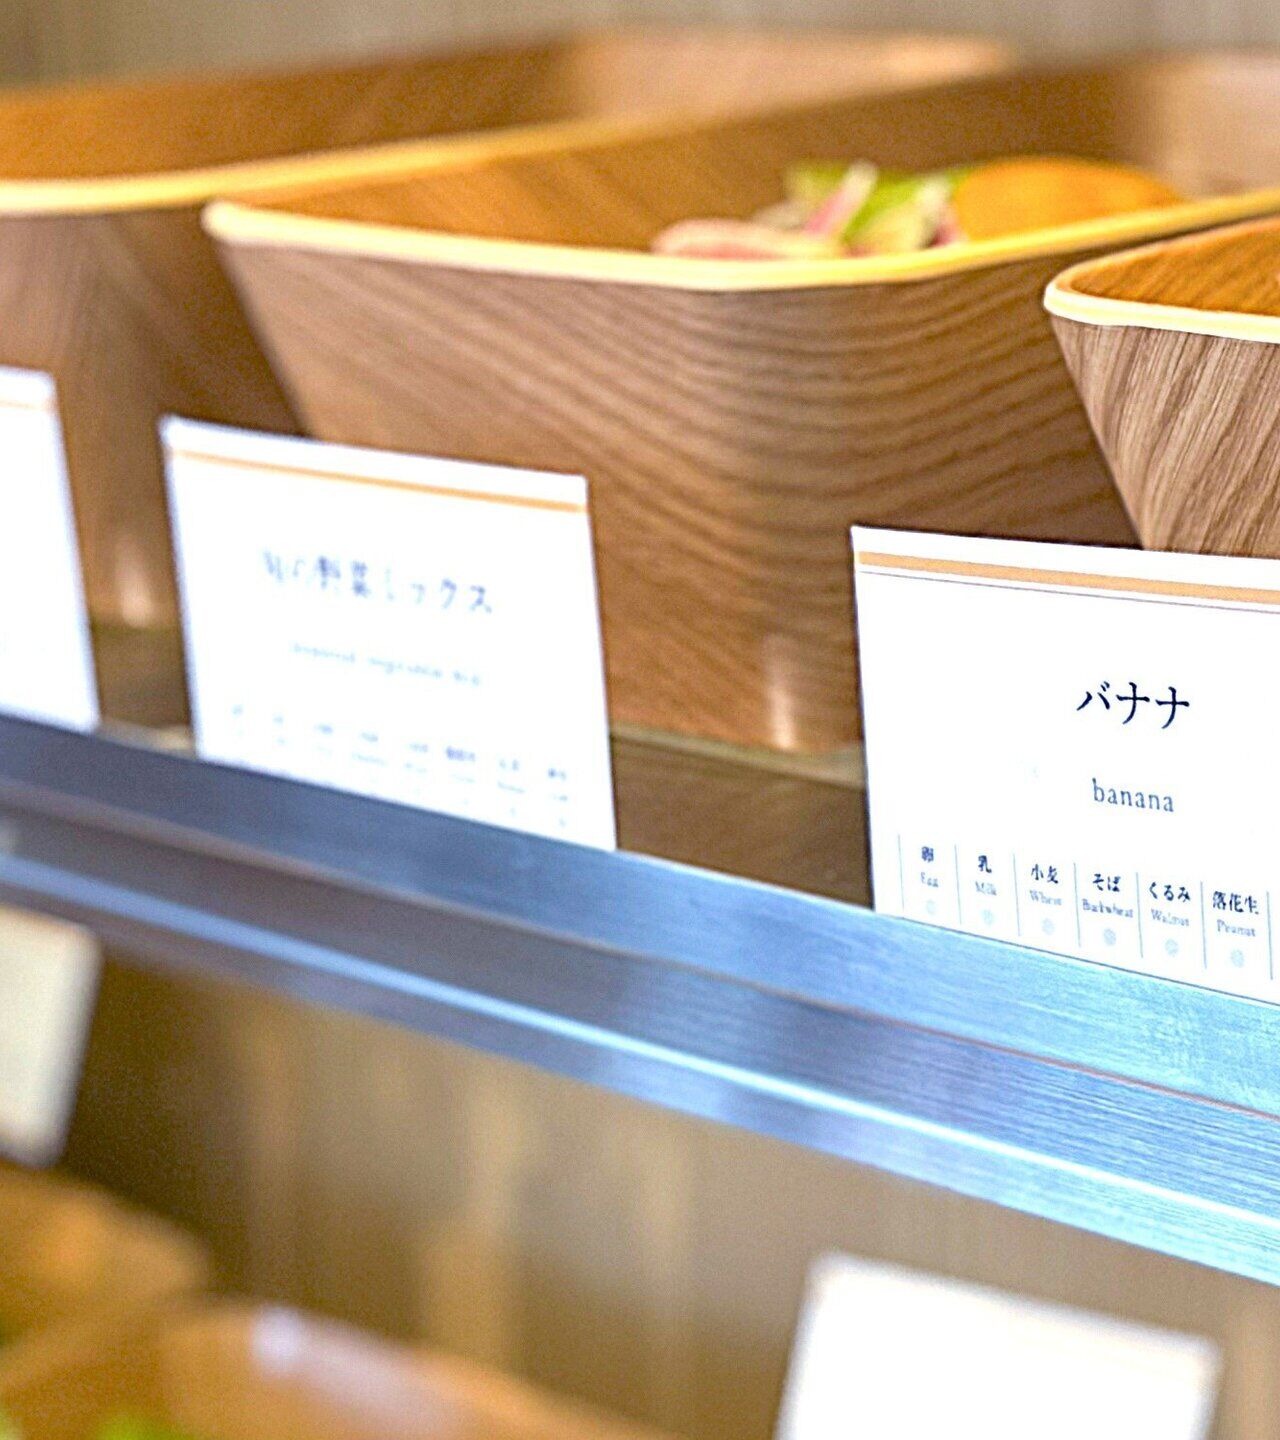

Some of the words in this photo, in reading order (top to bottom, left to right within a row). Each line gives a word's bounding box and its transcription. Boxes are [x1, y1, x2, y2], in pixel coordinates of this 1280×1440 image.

[1076, 680, 1190, 729] バナナ
[1091, 777, 1175, 813] banana
[977, 855, 992, 873] 乳
[1031, 864, 1059, 884] 小麦
[1092, 874, 1122, 892] そば
[1149, 881, 1191, 903] くるみ
[1212, 890, 1259, 915] 落花生
